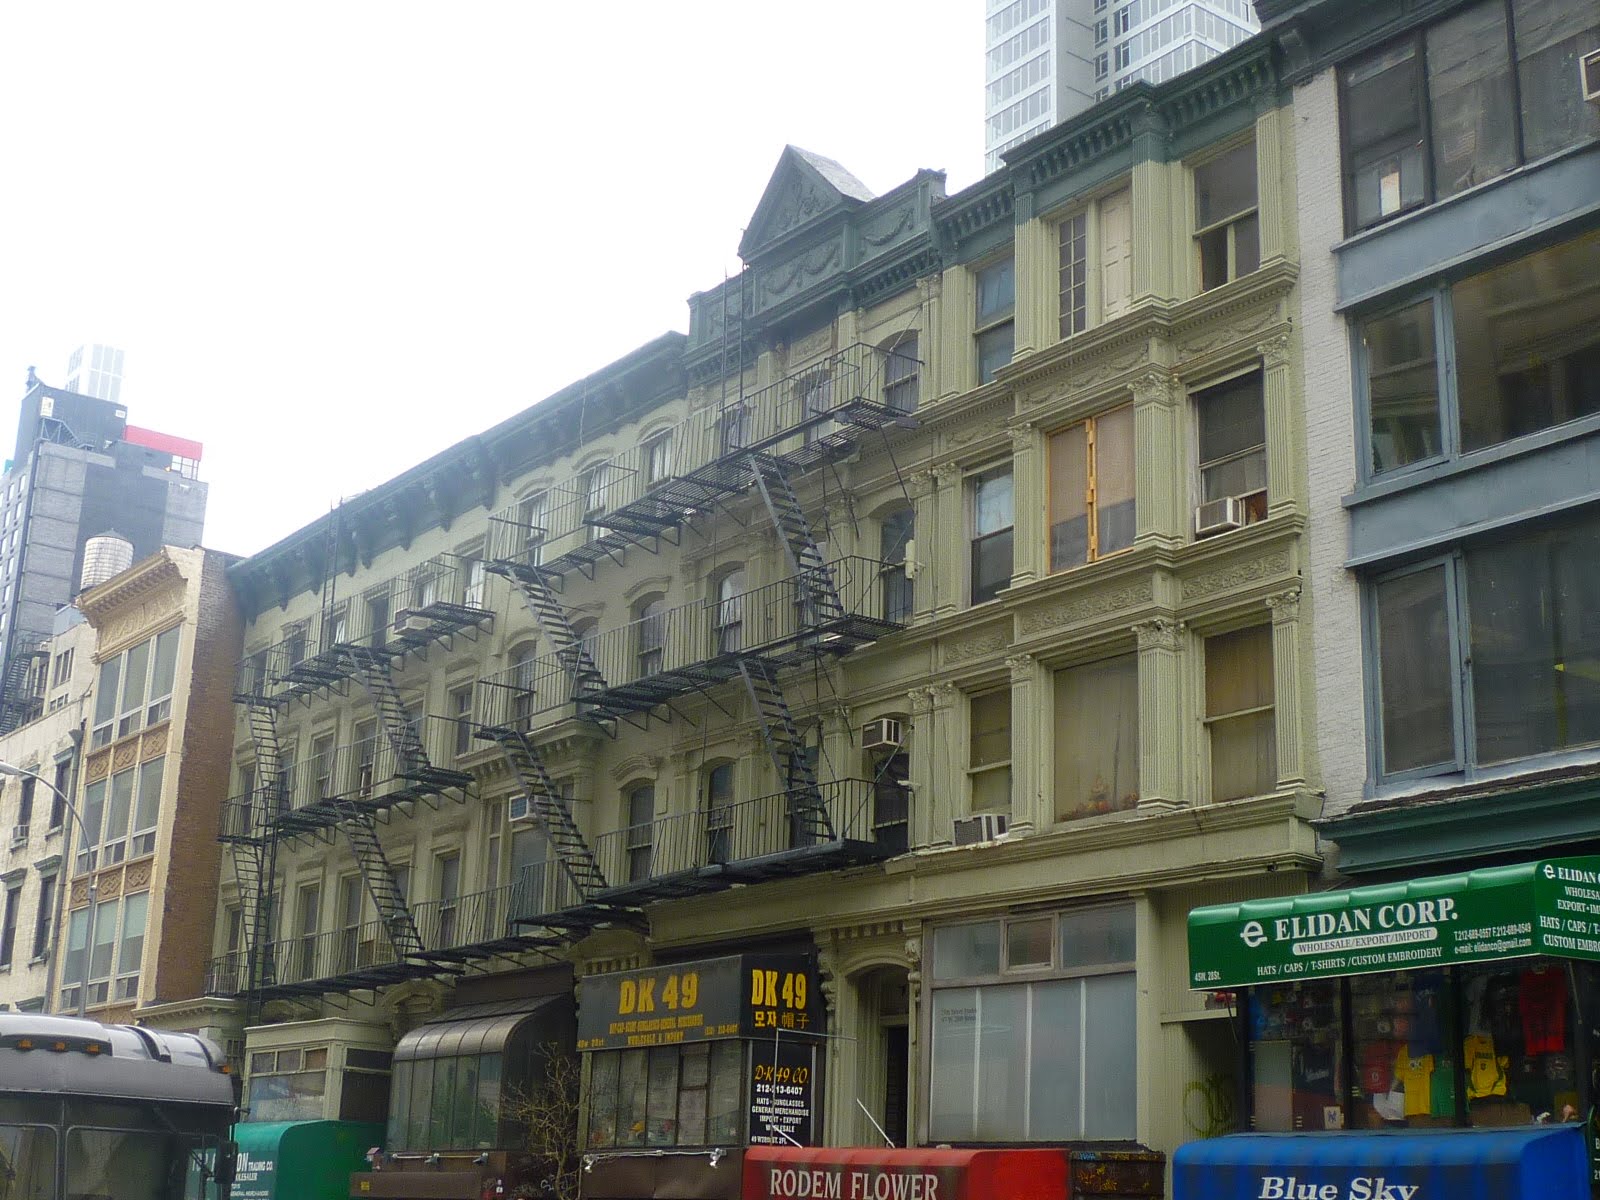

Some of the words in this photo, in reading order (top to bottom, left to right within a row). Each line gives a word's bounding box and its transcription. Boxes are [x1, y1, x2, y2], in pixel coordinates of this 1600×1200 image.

[1558, 867, 1596, 884] ELIDAN
[1275, 908, 1371, 941] ELIDAN
[1378, 898, 1458, 929] CORP.
[1540, 915, 1560, 930] HATS
[1567, 919, 1587, 933] CAPS
[1543, 933, 1576, 950] CUSTOM
[1257, 965, 1277, 976] HATS
[1284, 962, 1303, 973] CAPS
[1311, 957, 1346, 970] T-SHIRTS
[1388, 947, 1443, 963] EMBROIDERY
[618, 977, 656, 1015] DK
[662, 971, 699, 1010] 49
[752, 968, 778, 1007] DK
[782, 972, 807, 1010] 49
[754, 1011, 776, 1028] 모자
[781, 1012, 810, 1030] 帽子
[776, 1066, 790, 1083] 49
[774, 1107, 810, 1116] MERCHANDISE
[783, 1116, 802, 1125] EXPORT
[769, 1169, 841, 1200] RODEM
[850, 1171, 939, 1200] FLOWER
[1258, 1177, 1338, 1200] Blue
